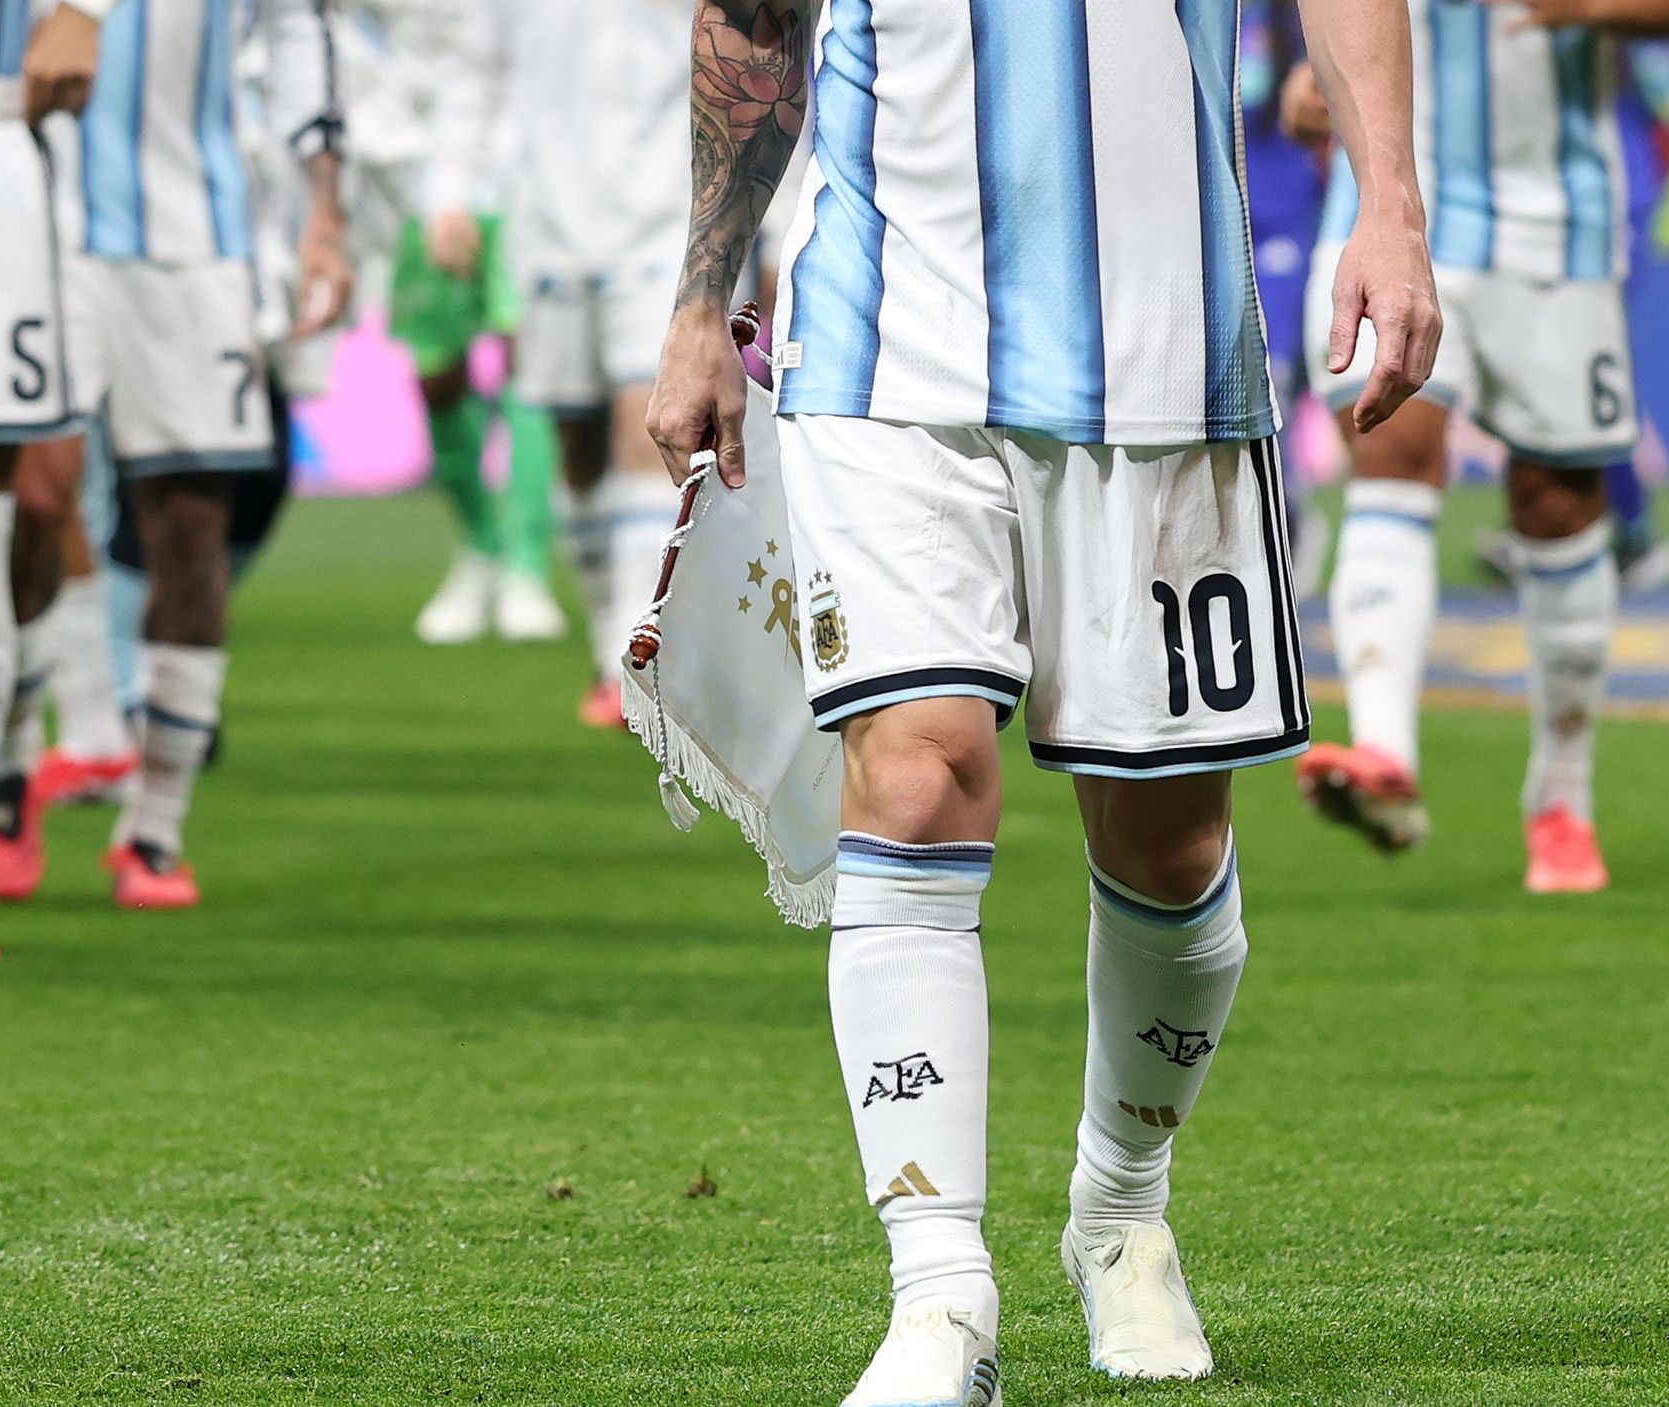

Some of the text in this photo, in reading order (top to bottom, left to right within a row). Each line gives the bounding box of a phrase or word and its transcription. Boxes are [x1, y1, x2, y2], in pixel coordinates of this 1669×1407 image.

[11, 318, 46, 402] 5
[220, 349, 253, 426] 7
[1589, 351, 1620, 428] 6
[1151, 573, 1255, 716] 10
[862, 1051, 944, 1109] AFA
[1135, 1016, 1215, 1067] AFA
